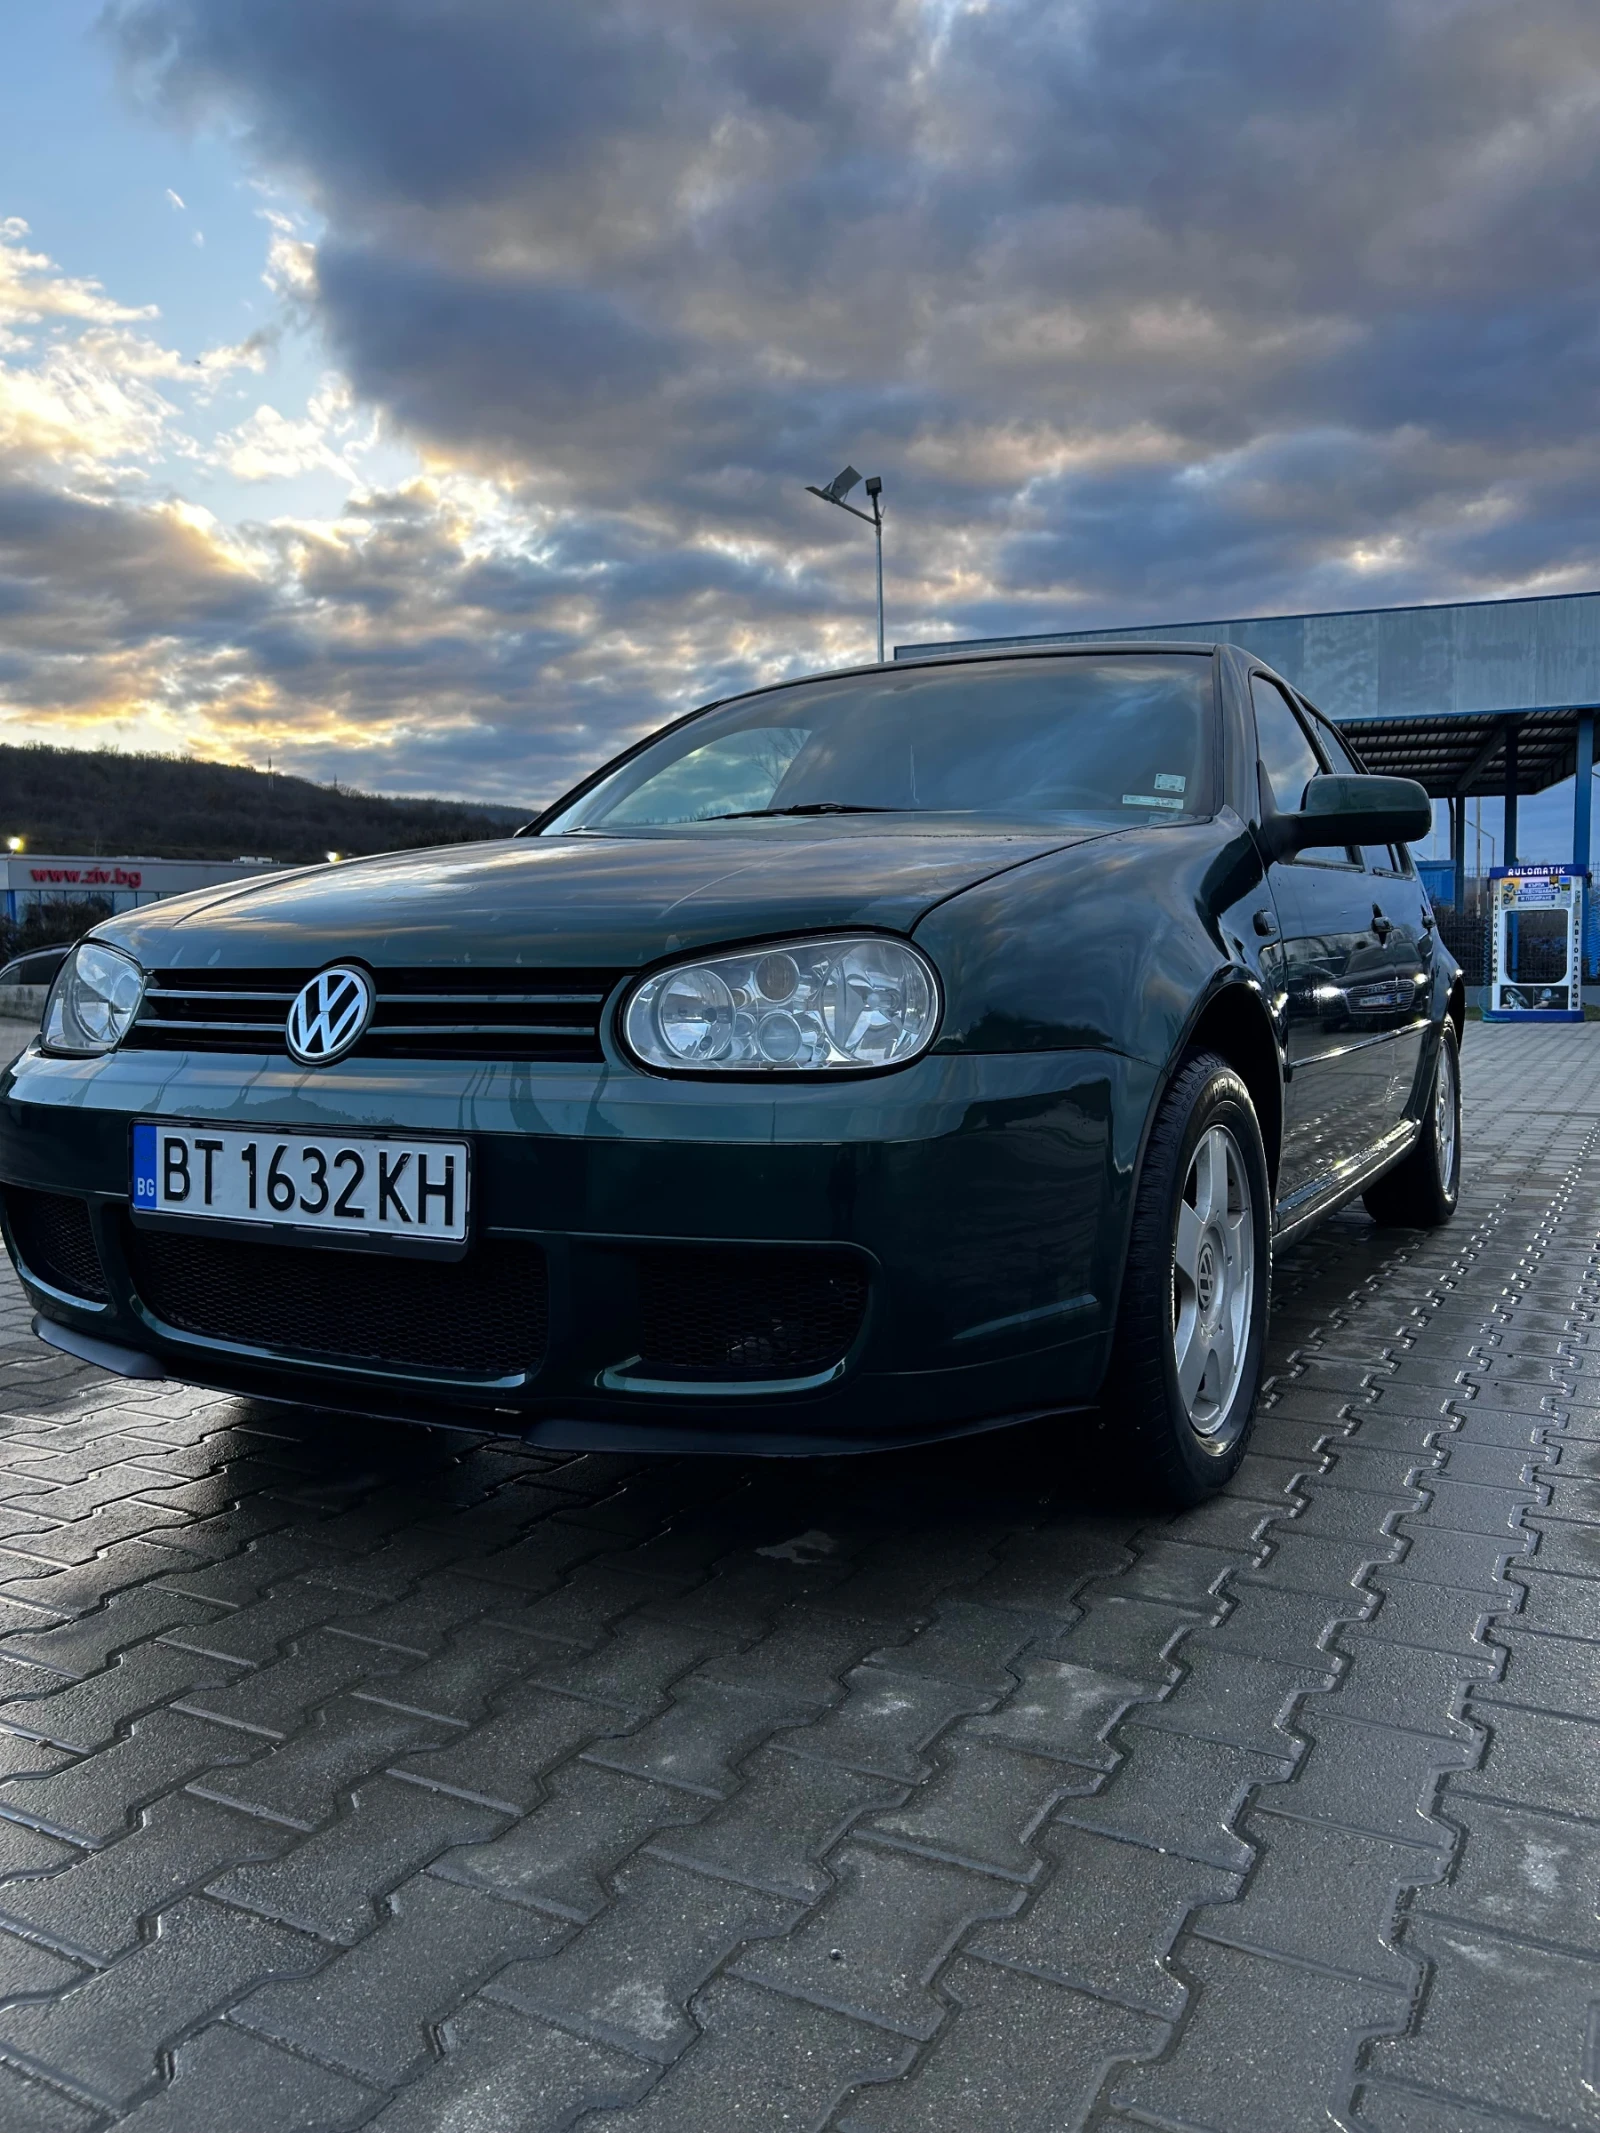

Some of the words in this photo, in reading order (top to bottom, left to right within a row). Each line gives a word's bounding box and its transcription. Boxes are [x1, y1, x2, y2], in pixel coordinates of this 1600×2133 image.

[31, 867, 142, 889] www.ziv.bg
[292, 970, 365, 1057] VW
[137, 1178, 155, 1197] BG
[163, 1136, 224, 1205] BT
[241, 1141, 366, 1219] 1632
[378, 1149, 455, 1227] KH
